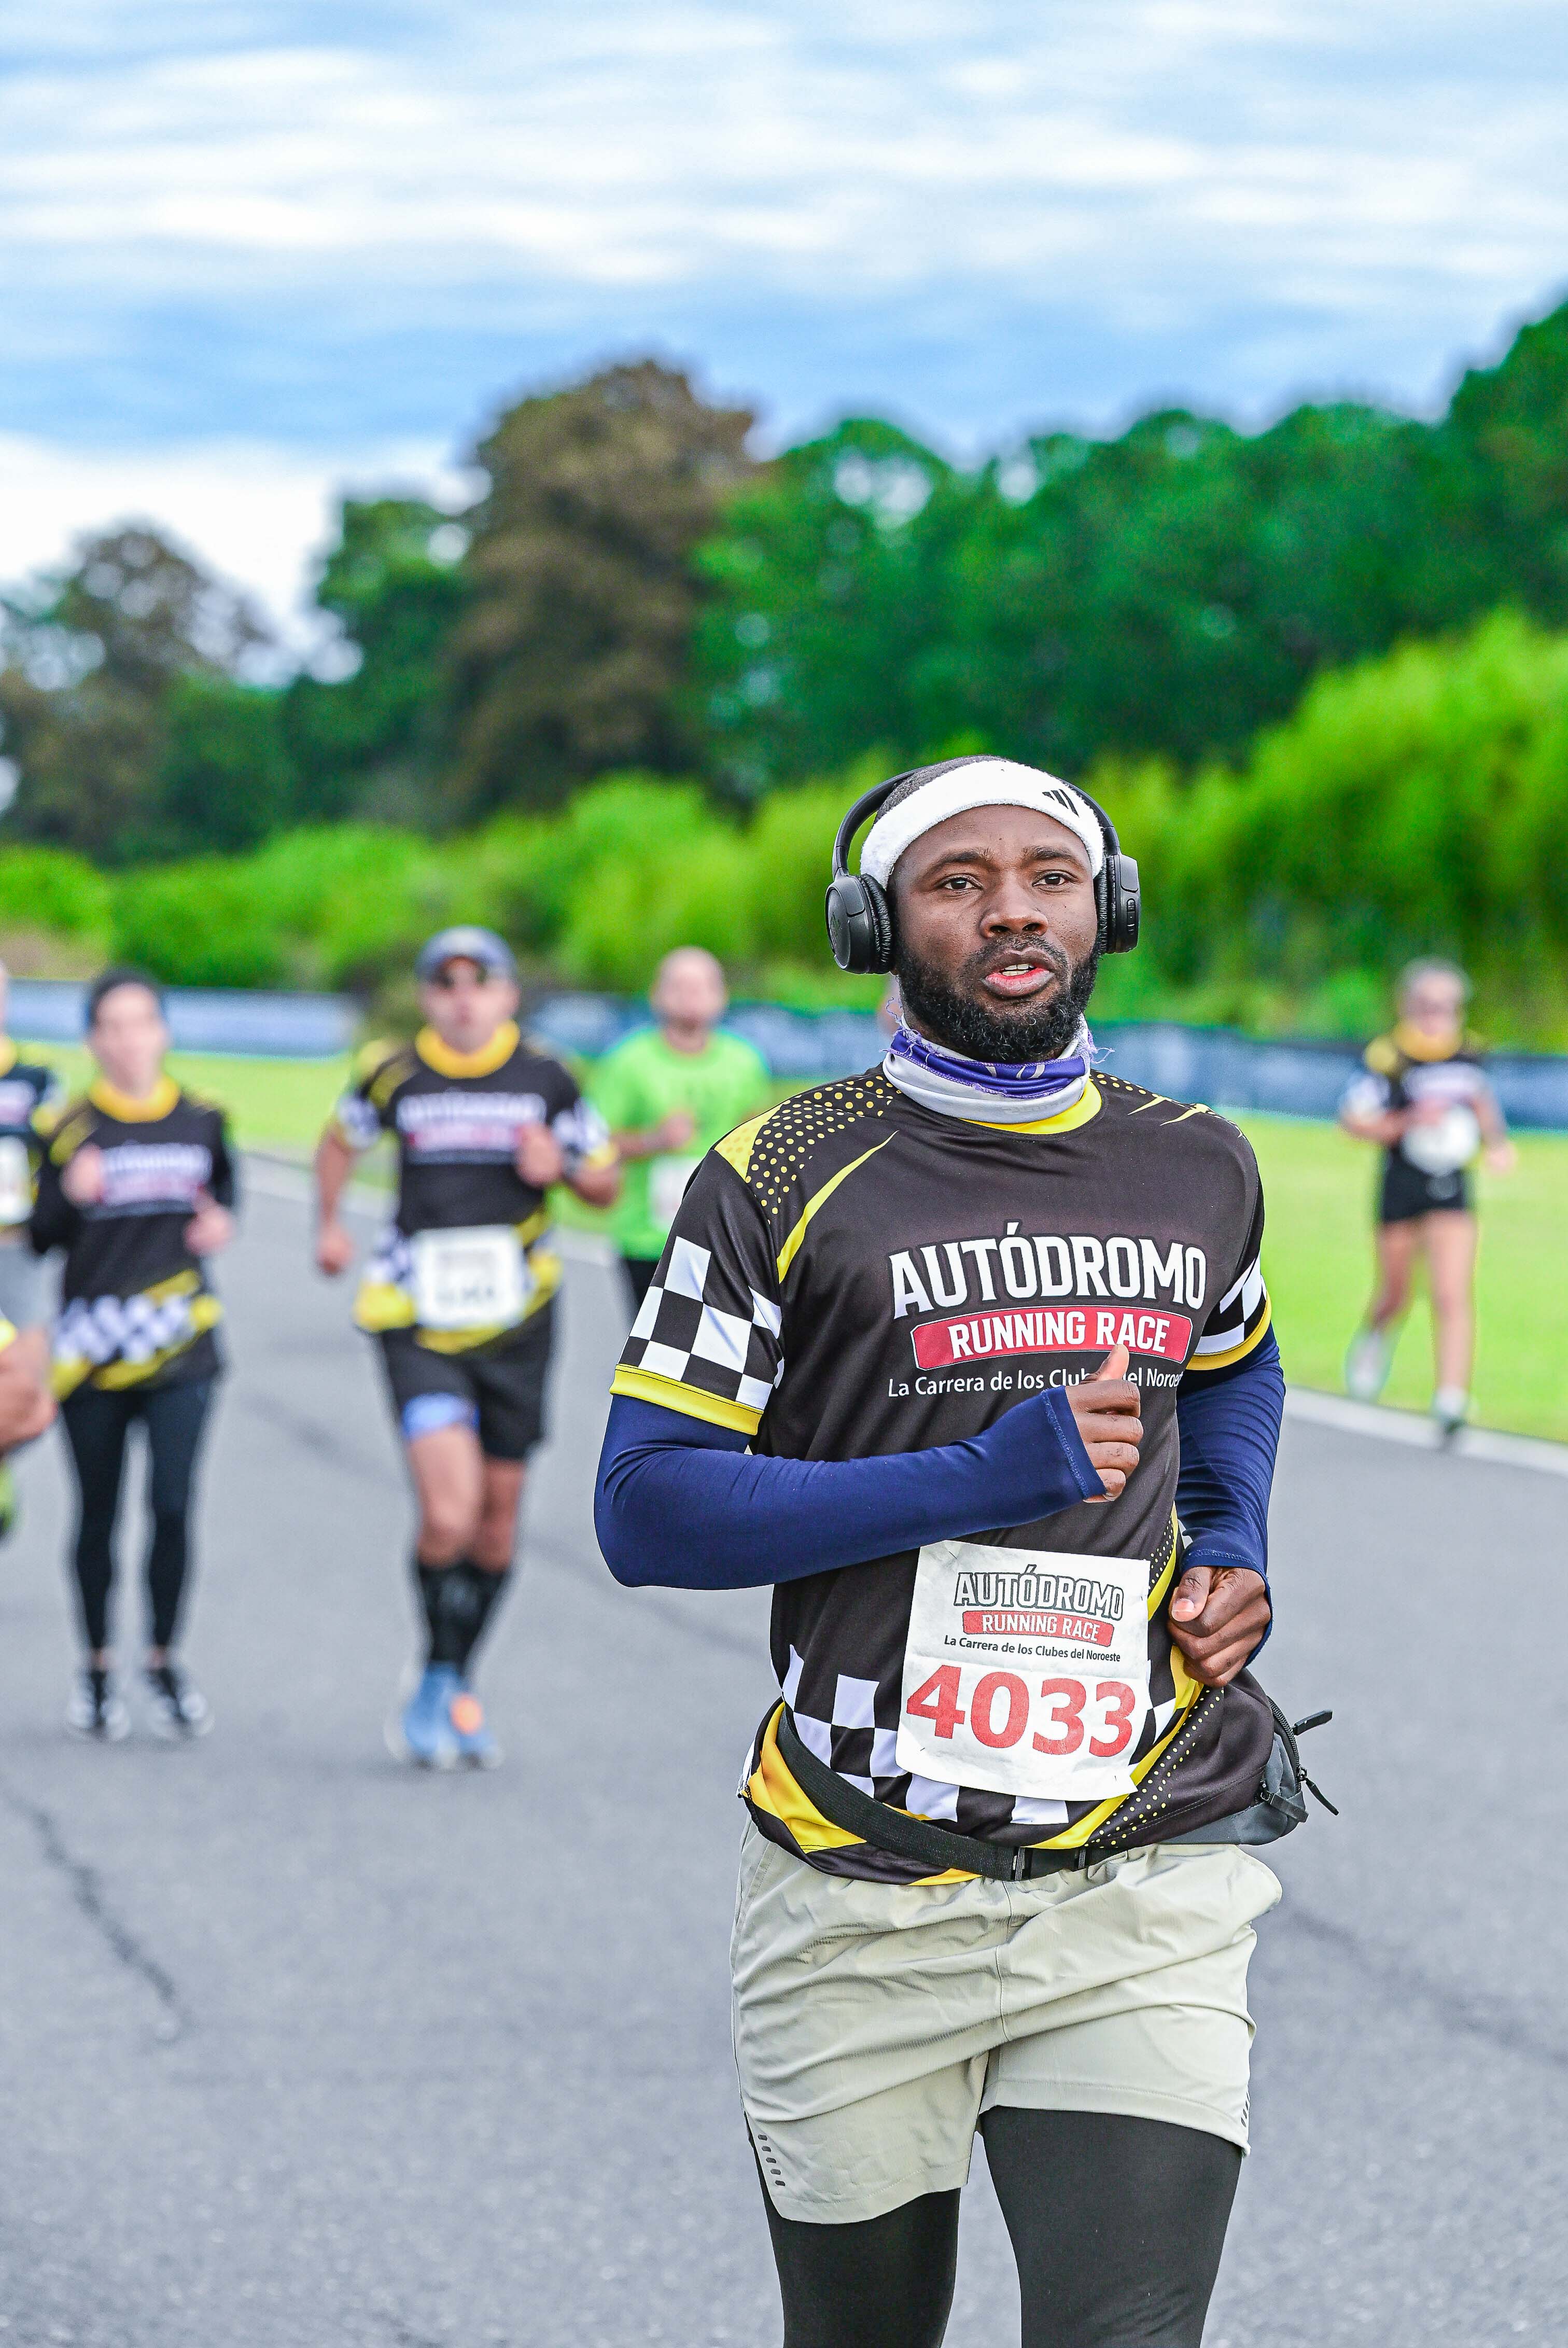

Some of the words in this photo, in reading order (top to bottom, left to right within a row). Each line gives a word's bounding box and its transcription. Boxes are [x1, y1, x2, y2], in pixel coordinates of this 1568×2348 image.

[889, 1222, 1206, 1319] AUTÓDROMO
[947, 1310, 1086, 1360] RUNNING
[1096, 1311, 1170, 1353] RACE
[888, 1378, 909, 1397] La
[915, 1376, 984, 1395] Carrera
[990, 1371, 1013, 1391] de
[1017, 1369, 1044, 1389] los
[954, 1564, 1124, 1620] AUTÓDROMO
[944, 1634, 956, 1646] La
[959, 1637, 999, 1652] Carrera
[1001, 1642, 1015, 1653] de
[1018, 1643, 1033, 1655] los
[1035, 1645, 1068, 1658] Clubes
[1070, 1648, 1084, 1659] del
[1087, 1650, 1121, 1662] Noroeste
[982, 1614, 1057, 1634] RUNNING
[1062, 1618, 1101, 1642] RACE
[906, 1664, 1136, 1757] 4033
